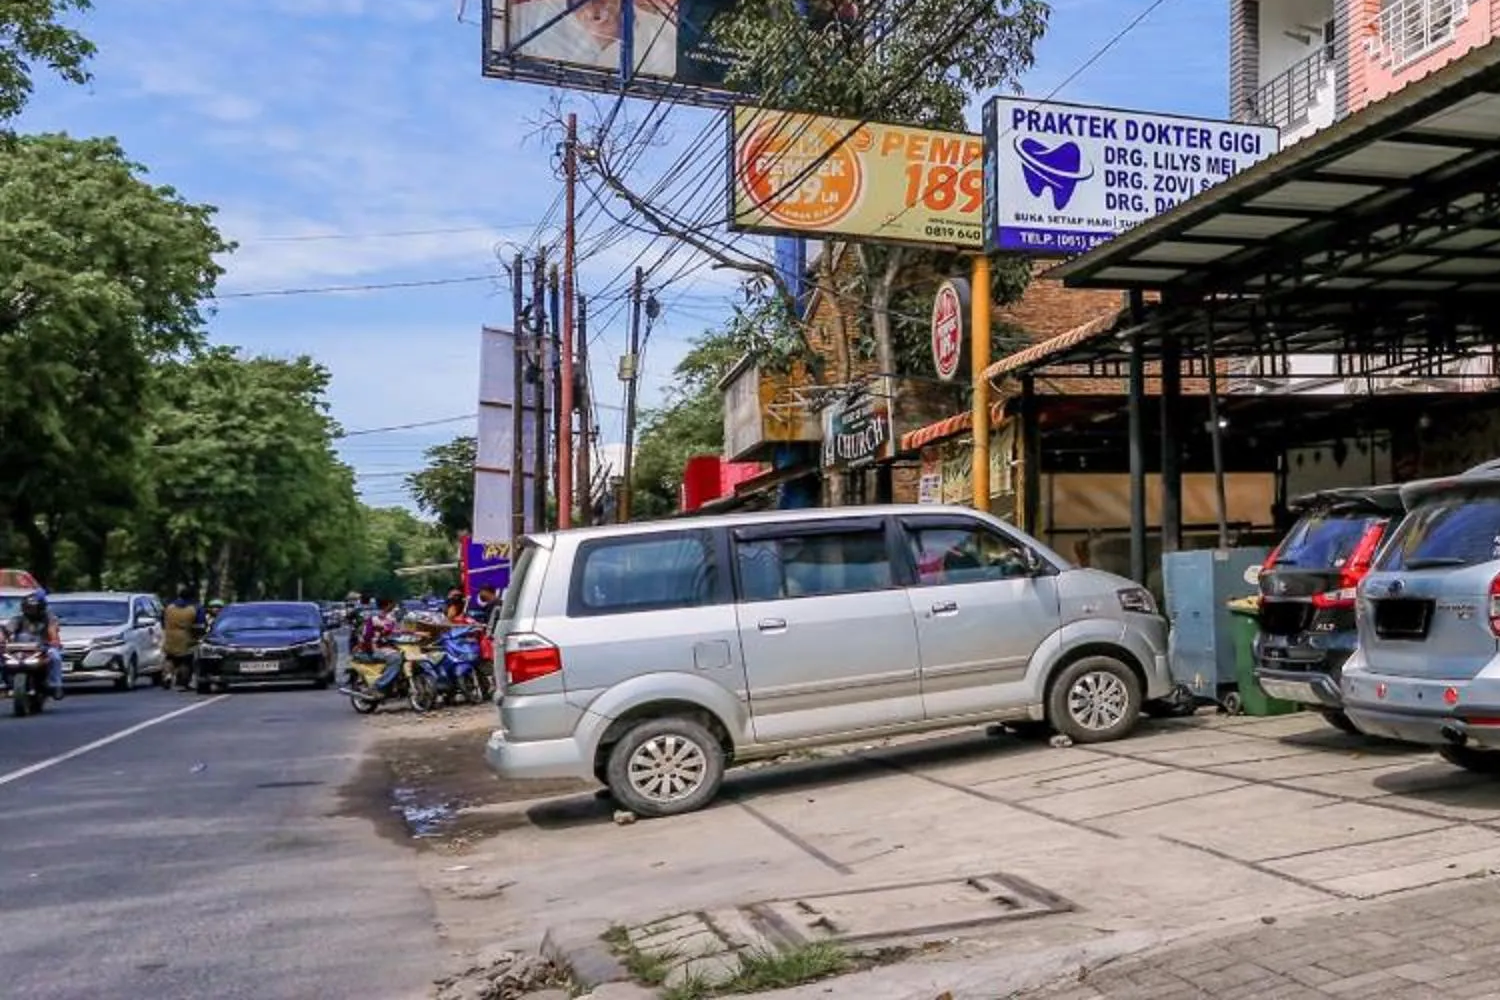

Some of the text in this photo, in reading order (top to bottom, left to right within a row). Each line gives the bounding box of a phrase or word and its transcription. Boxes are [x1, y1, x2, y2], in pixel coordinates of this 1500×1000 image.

[1012, 107, 1262, 155] PRAKTEK DOKTER GIGI
[1104, 145, 1148, 168] DRG.
[1153, 151, 1201, 174] LILYS
[903, 163, 983, 213] 189
[1104, 168, 1148, 191] DRG.
[1105, 191, 1149, 214] DRG.
[1019, 230, 1055, 246] TELP.
